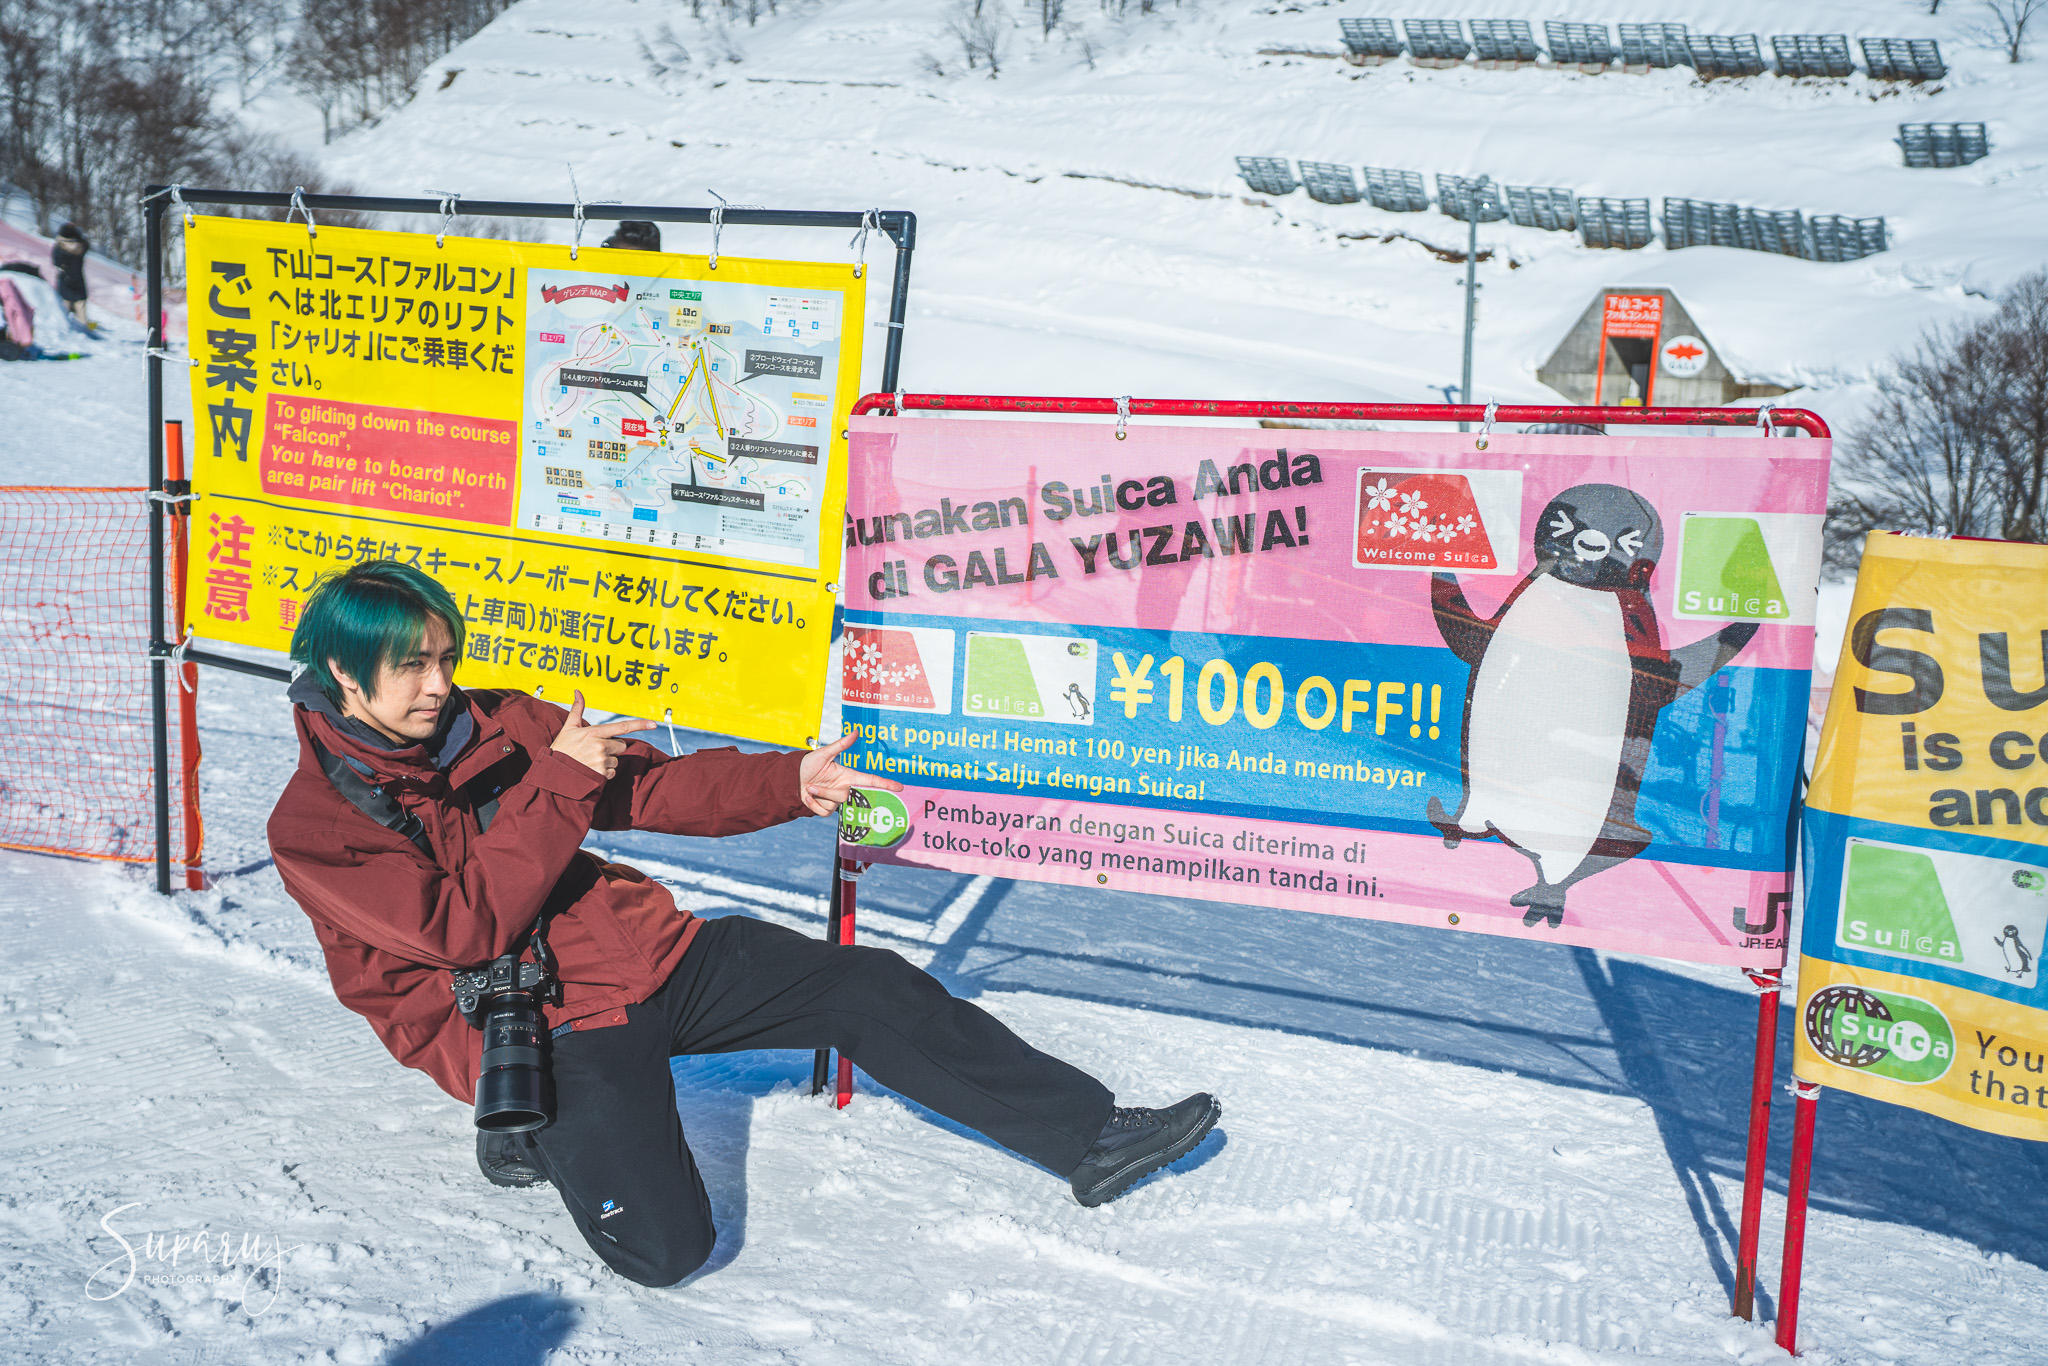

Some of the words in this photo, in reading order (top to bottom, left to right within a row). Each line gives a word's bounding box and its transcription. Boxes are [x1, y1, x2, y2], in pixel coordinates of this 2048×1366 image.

[266, 247, 515, 299] 下山コース「ファルコン」
[590, 287, 608, 298] MAP
[268, 288, 514, 335] へは北エリアのリフト
[1605, 310, 1660, 321] ファルコン入口
[1607, 296, 1660, 310] 下山コース
[205, 261, 258, 462] ご案内
[271, 320, 514, 375] 「シャリオ」にご乗車くだ
[1669, 361, 1697, 370] GALA
[270, 359, 322, 391] さい。
[275, 400, 295, 420] To
[300, 406, 356, 431] gliding
[362, 411, 410, 433] down
[416, 417, 445, 437] the
[450, 425, 511, 445] course
[623, 421, 645, 433] 現在地
[788, 416, 815, 426] 北エリア
[267, 468, 304, 487] area
[309, 473, 346, 493] pair
[351, 477, 376, 497] lift
[271, 445, 305, 465] You
[312, 449, 357, 472] have
[364, 457, 383, 474] to
[389, 459, 445, 483] board
[452, 467, 507, 491] North
[1040, 473, 1178, 521] Suica
[1192, 448, 1323, 500] Anda
[203, 512, 255, 623] 注意
[868, 560, 909, 600] di
[923, 542, 1059, 595] GALA
[1069, 506, 1310, 575] YUZAWA!
[1363, 547, 1437, 561] Welcome
[1443, 550, 1489, 563] Suica
[1684, 590, 1783, 616] Suica
[895, 693, 930, 704] Suica
[970, 694, 1040, 714] Suica
[1110, 651, 1285, 730] ¥100
[1295, 675, 1442, 740] OFF!!
[841, 715, 899, 745] angat
[904, 726, 997, 748] populer!
[1004, 730, 1078, 756] Hemat
[1085, 737, 1126, 760] 100
[1131, 745, 1172, 767] yen
[1176, 745, 1220, 772] jika
[1226, 749, 1287, 775] Anda
[1294, 759, 1427, 791] membayar
[1900, 722, 1963, 771] is
[1989, 730, 2048, 771] c
[866, 750, 979, 781] Menikmati
[985, 761, 1040, 790] Salju
[1046, 768, 1131, 796] dengan
[1137, 775, 1206, 801] Suica!
[845, 807, 906, 828] Suica
[923, 799, 1061, 832] Pembayaran
[1069, 814, 1155, 843] dengan
[1163, 823, 1225, 850] Suica
[1232, 831, 1335, 862] diterima
[1343, 842, 1367, 864] di
[923, 831, 1031, 859] toko-toko
[1038, 846, 1093, 870] yang
[1100, 853, 1261, 884] menampilkan
[1269, 866, 1339, 893] tanda
[1346, 875, 1385, 898] ini.
[1849, 920, 1957, 958] Suica
[1841, 1014, 1950, 1060] Suica
[1976, 1030, 2044, 1073] You
[1970, 1069, 2048, 1109] that
